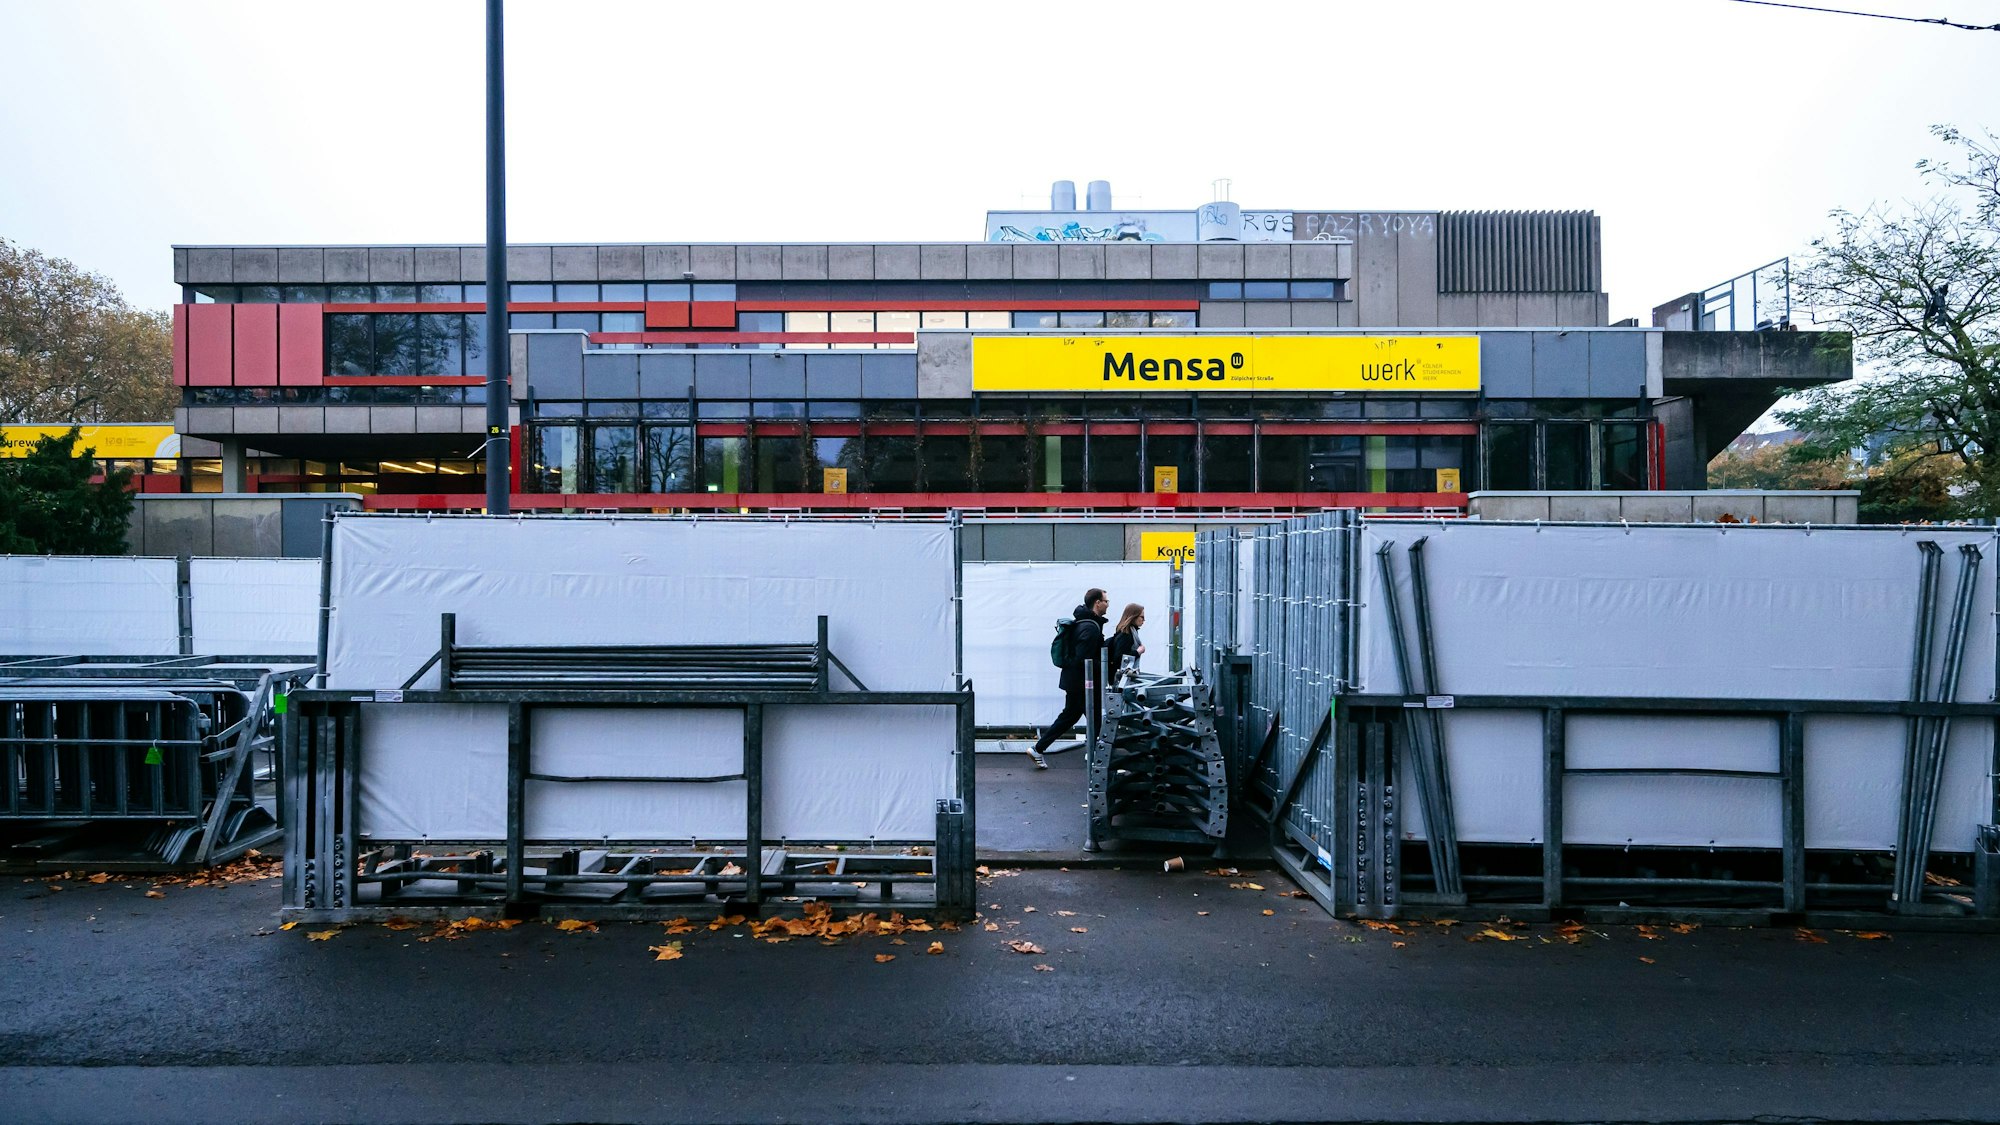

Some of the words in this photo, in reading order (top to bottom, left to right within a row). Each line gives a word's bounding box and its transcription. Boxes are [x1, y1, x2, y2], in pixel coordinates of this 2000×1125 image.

[1103, 352, 1225, 381] Mensa
[1361, 358, 1416, 381] werk
[1158, 546, 1195, 557] Konfe
